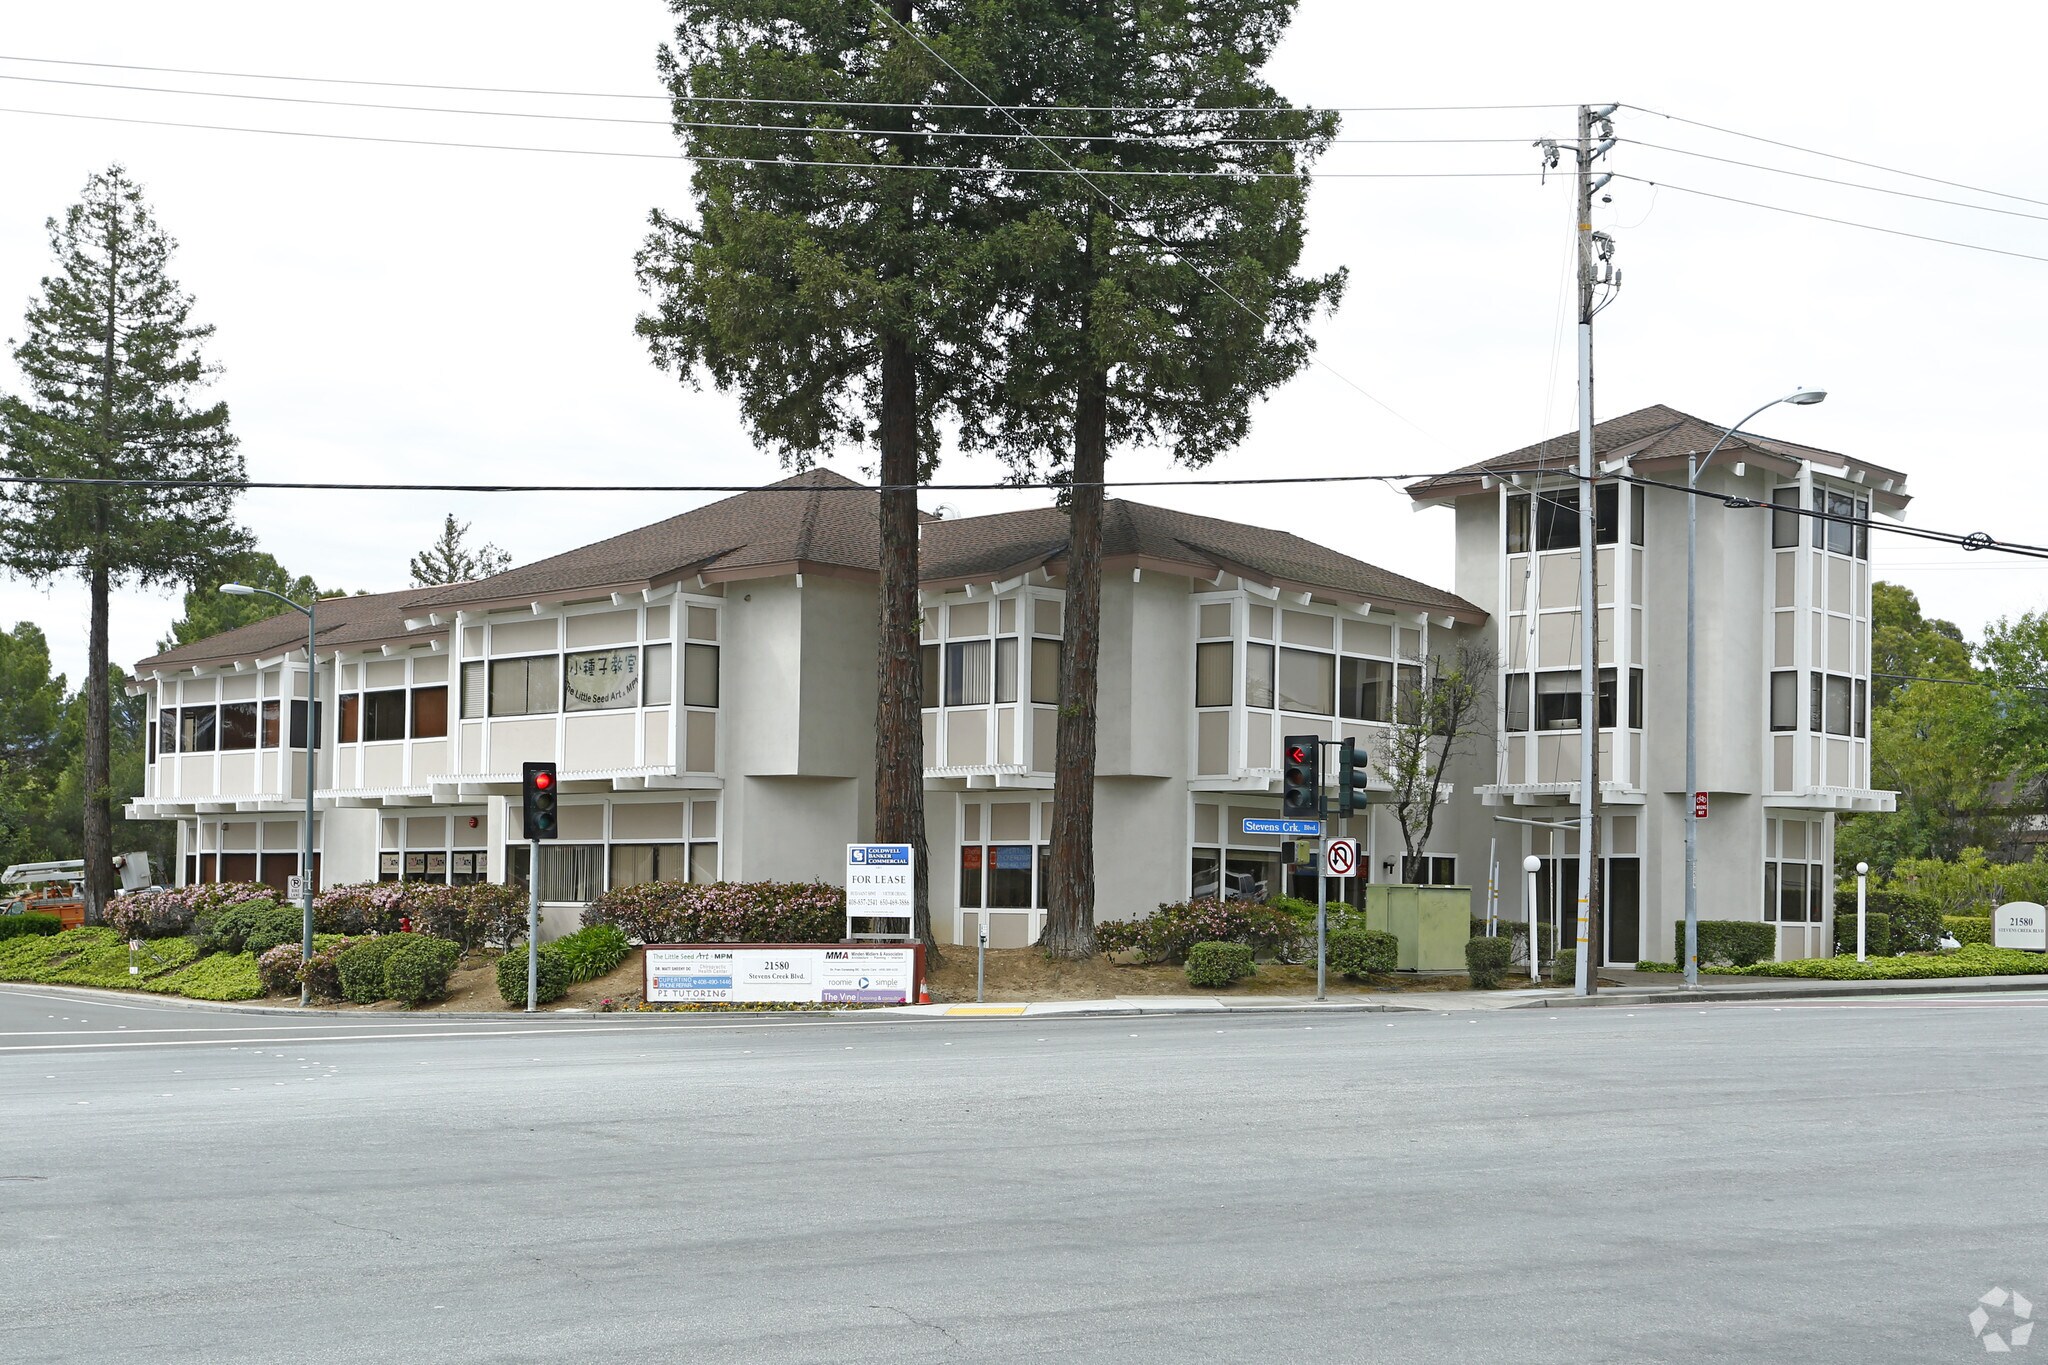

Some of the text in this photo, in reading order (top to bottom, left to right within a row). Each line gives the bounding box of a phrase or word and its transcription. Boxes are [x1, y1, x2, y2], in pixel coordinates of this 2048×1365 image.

[575, 689, 592, 703] Little
[592, 694, 609, 703] Seed
[610, 690, 622, 701] Art
[1245, 821, 1280, 832] Stevens
[1282, 822, 1301, 832] Crk.
[852, 875, 906, 884] FOR LEASE
[2010, 917, 2033, 927] 21580
[695, 952, 709, 960] Art
[825, 951, 849, 960] MMA
[764, 961, 790, 971] 21580
[748, 972, 805, 980] Stevens Creek Blvd.
[875, 978, 898, 988] simple
[823, 993, 838, 1001] The
[839, 993, 857, 1001] Vine
